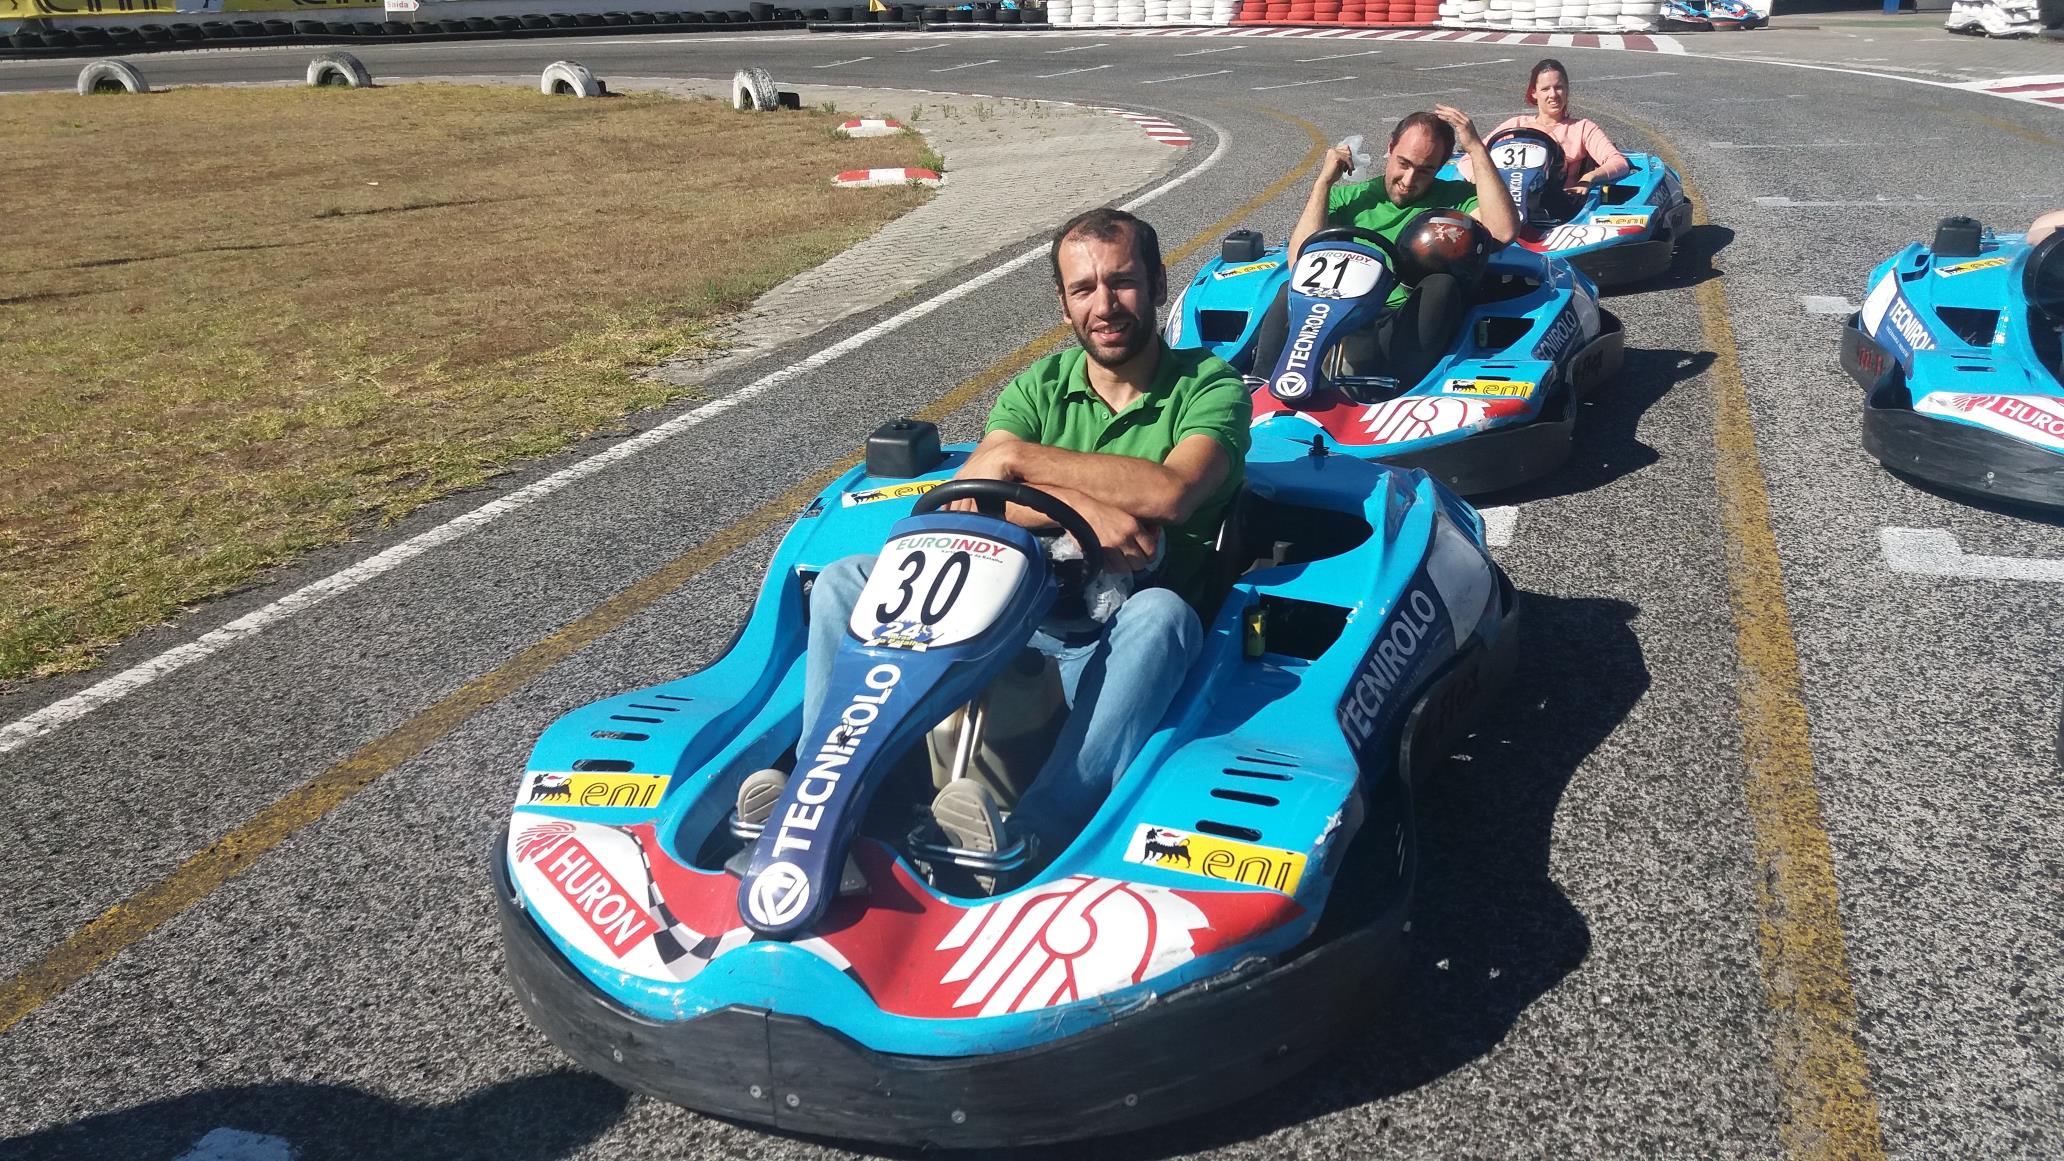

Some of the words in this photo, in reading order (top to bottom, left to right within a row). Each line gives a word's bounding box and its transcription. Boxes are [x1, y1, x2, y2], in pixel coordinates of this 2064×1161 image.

[1503, 148, 1527, 166] 31
[1301, 257, 1350, 290] 21
[1310, 252, 1373, 264] EUROINDY
[1286, 303, 1331, 371] TECNIROLO
[1889, 296, 1935, 350] TECNIROL
[1483, 382, 1530, 398] eni
[895, 480, 947, 498] en
[896, 537, 1007, 557] EUROINDY
[876, 551, 971, 626] 30
[1341, 590, 1436, 750] TECNIROLO
[771, 663, 901, 857] TECNIROLO
[580, 775, 662, 807] eni
[1203, 850, 1293, 891] eni
[547, 845, 646, 947] HURON
